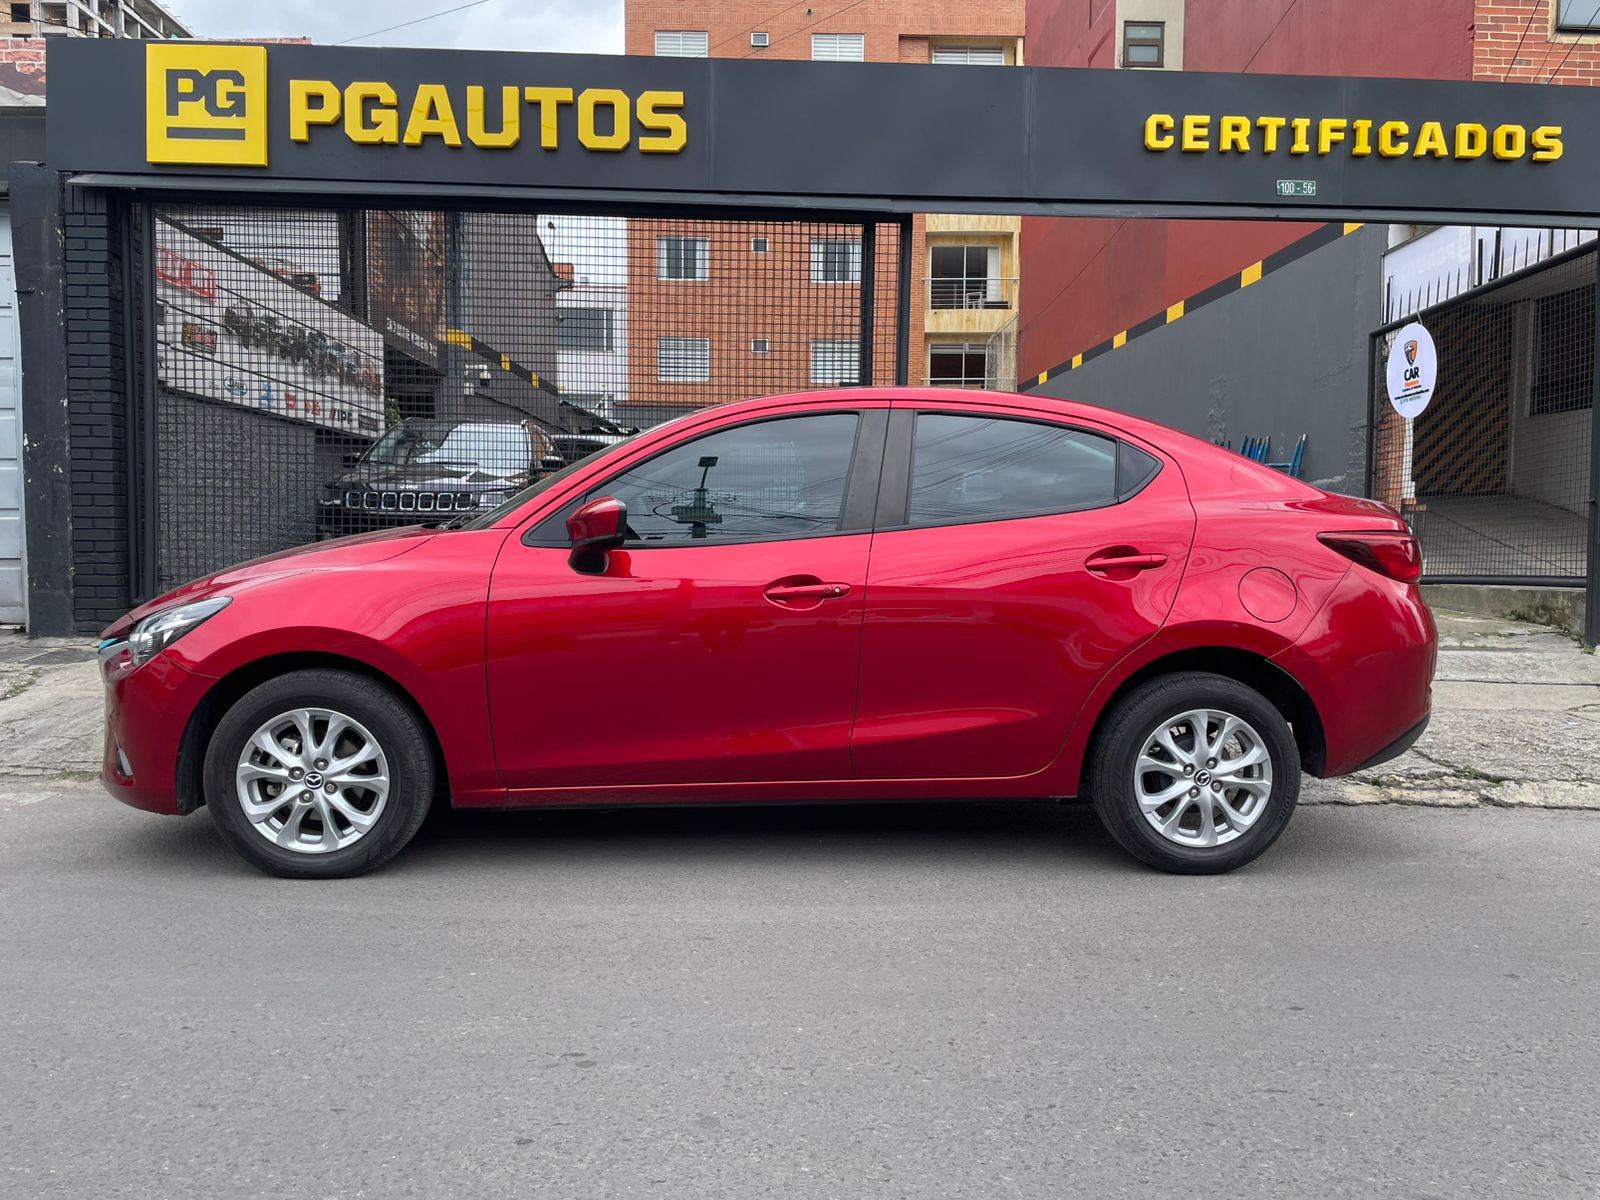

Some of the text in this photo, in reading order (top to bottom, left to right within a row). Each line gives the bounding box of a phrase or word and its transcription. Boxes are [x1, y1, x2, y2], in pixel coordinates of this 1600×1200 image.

[166, 68, 246, 118] PG
[289, 79, 687, 153] PGAUTOS
[1144, 113, 1564, 162] CERTIFICADOS
[1280, 182, 1295, 193] 100
[1302, 182, 1313, 194] 56
[1404, 366, 1420, 381] CAR
